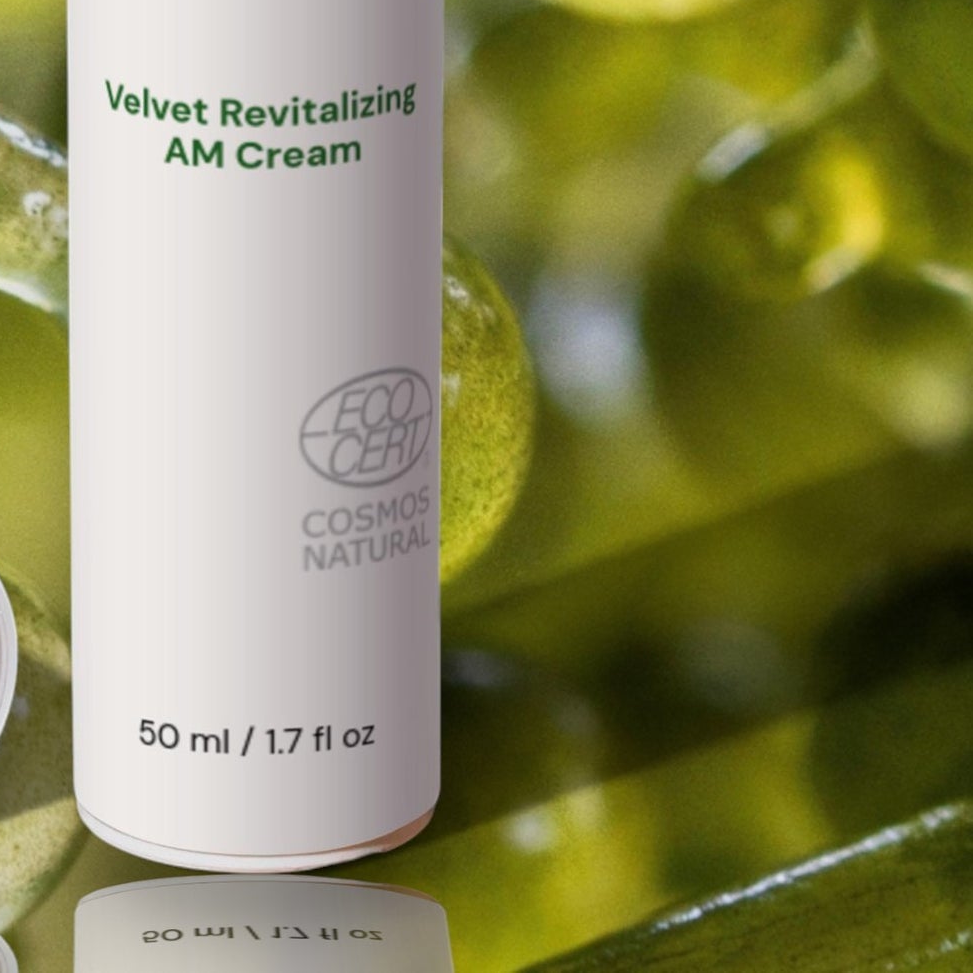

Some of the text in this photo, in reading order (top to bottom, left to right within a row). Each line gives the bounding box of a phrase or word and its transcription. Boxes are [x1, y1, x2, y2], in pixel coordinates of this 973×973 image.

[105, 79, 416, 127] Velvet Revitalizing
[164, 137, 362, 170] AM Cream
[333, 377, 414, 434] ECO
[330, 413, 425, 477] CERT
[302, 486, 430, 538] COSMOS
[303, 522, 430, 571] NATURAL
[139, 719, 376, 756] 50 ml / 1.7 fl oz
